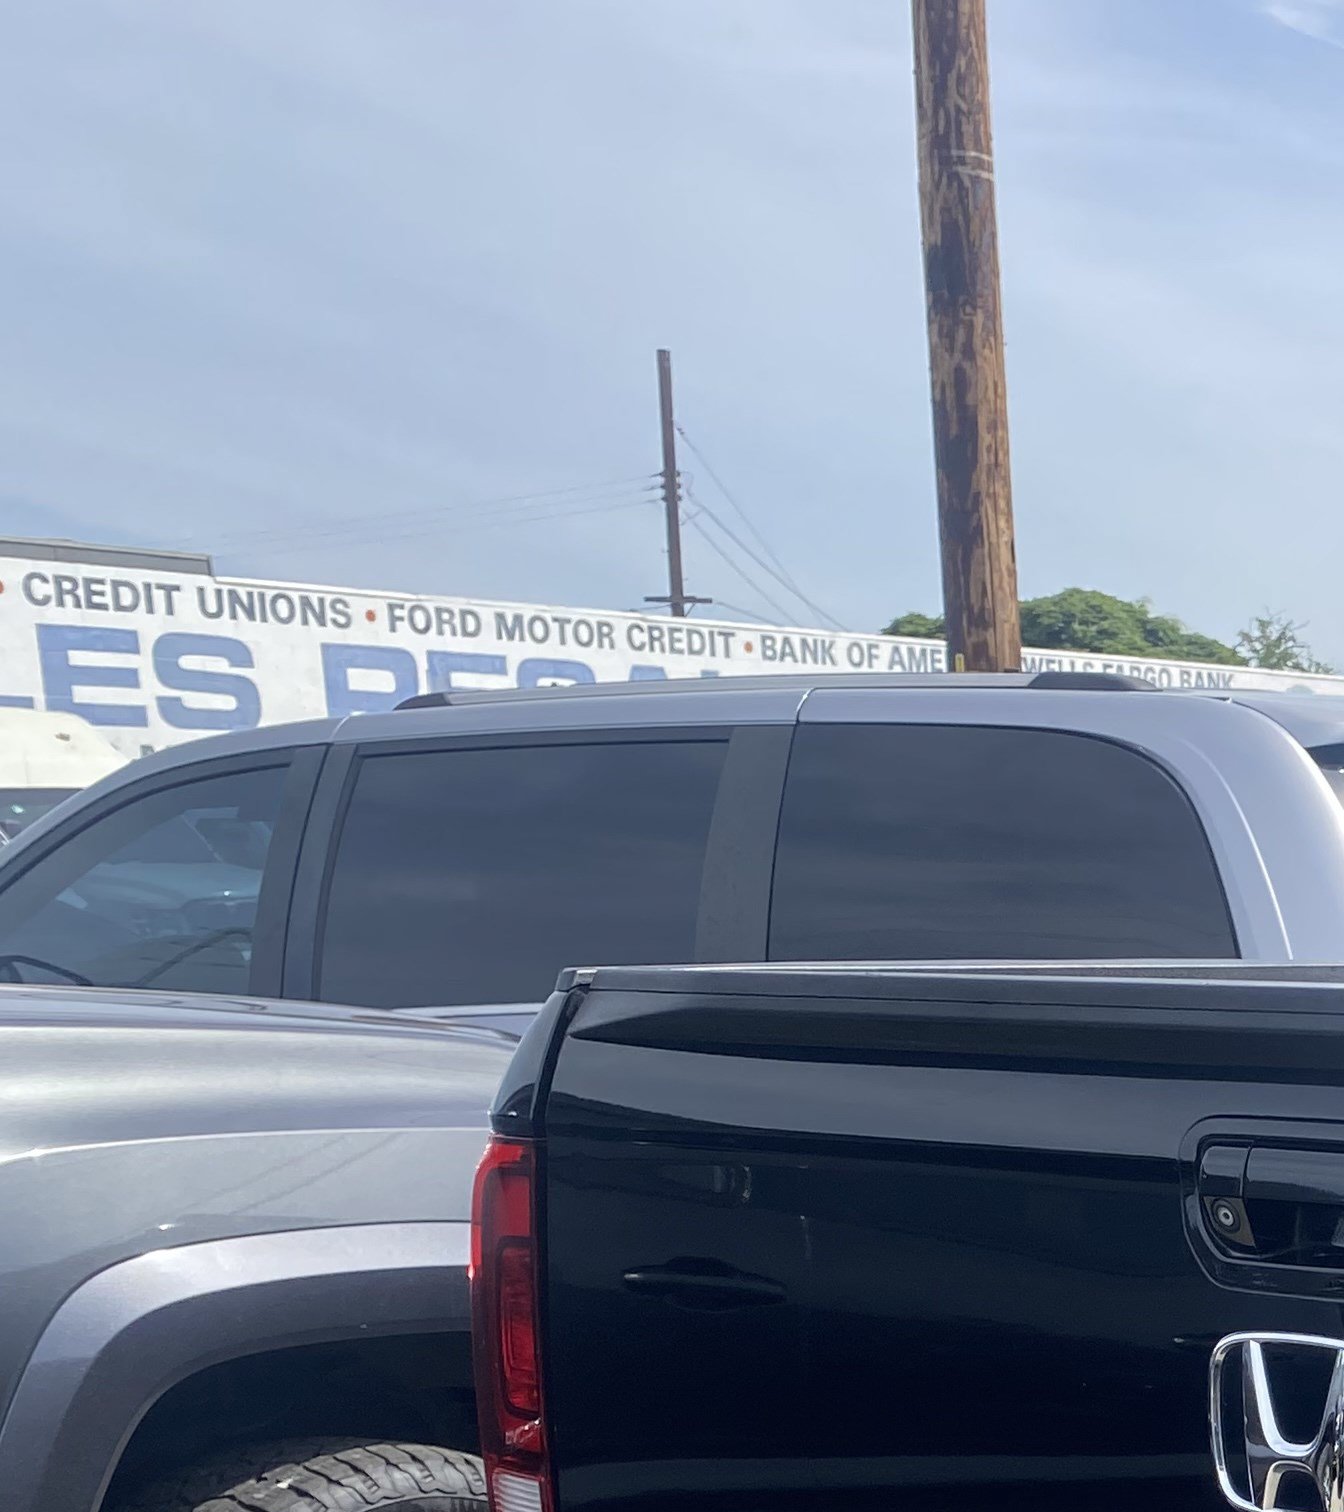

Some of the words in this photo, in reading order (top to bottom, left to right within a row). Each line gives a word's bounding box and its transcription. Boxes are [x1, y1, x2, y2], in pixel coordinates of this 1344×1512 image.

[0, 623, 262, 731] ES
[22, 572, 180, 616] CREDIT
[197, 585, 352, 629] UNIONS
[386, 602, 482, 639] FORD
[495, 612, 615, 650] MOTOR
[626, 622, 735, 658] CREDIT
[760, 633, 838, 667] BANK
[846, 641, 880, 669] OF
[887, 645, 945, 673] AME
[1179, 669, 1234, 689] BANK
